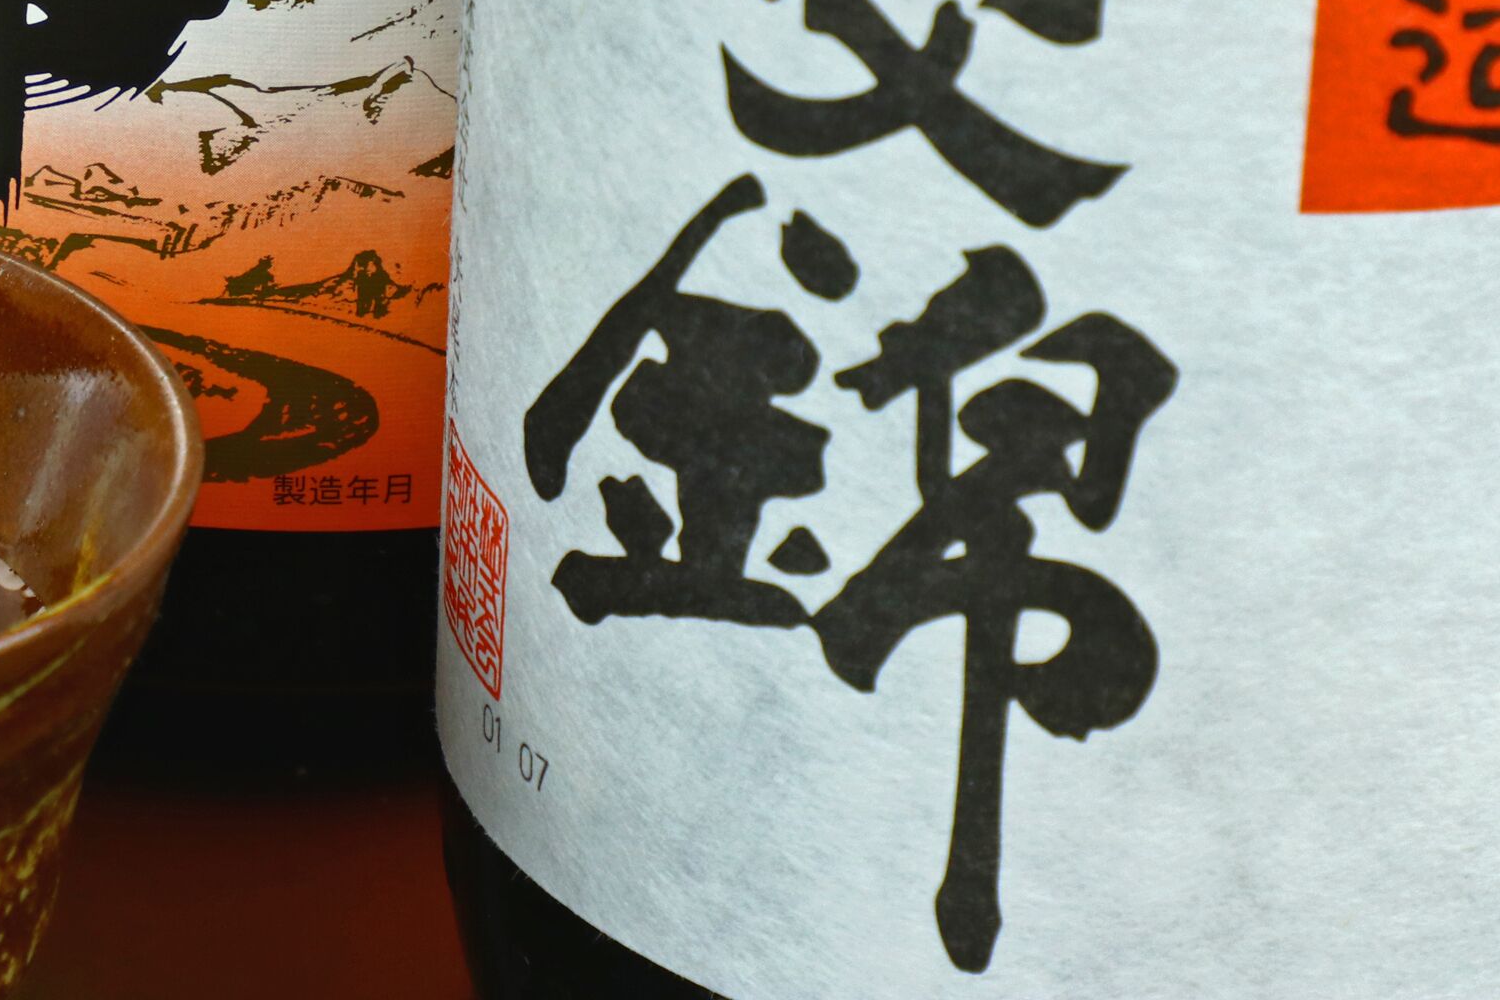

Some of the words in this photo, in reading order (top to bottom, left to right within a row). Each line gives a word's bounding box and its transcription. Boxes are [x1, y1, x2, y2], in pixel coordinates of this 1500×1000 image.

[272, 474, 412, 506] 製造年月
[482, 703, 501, 753] 01
[519, 742, 550, 792] 07
